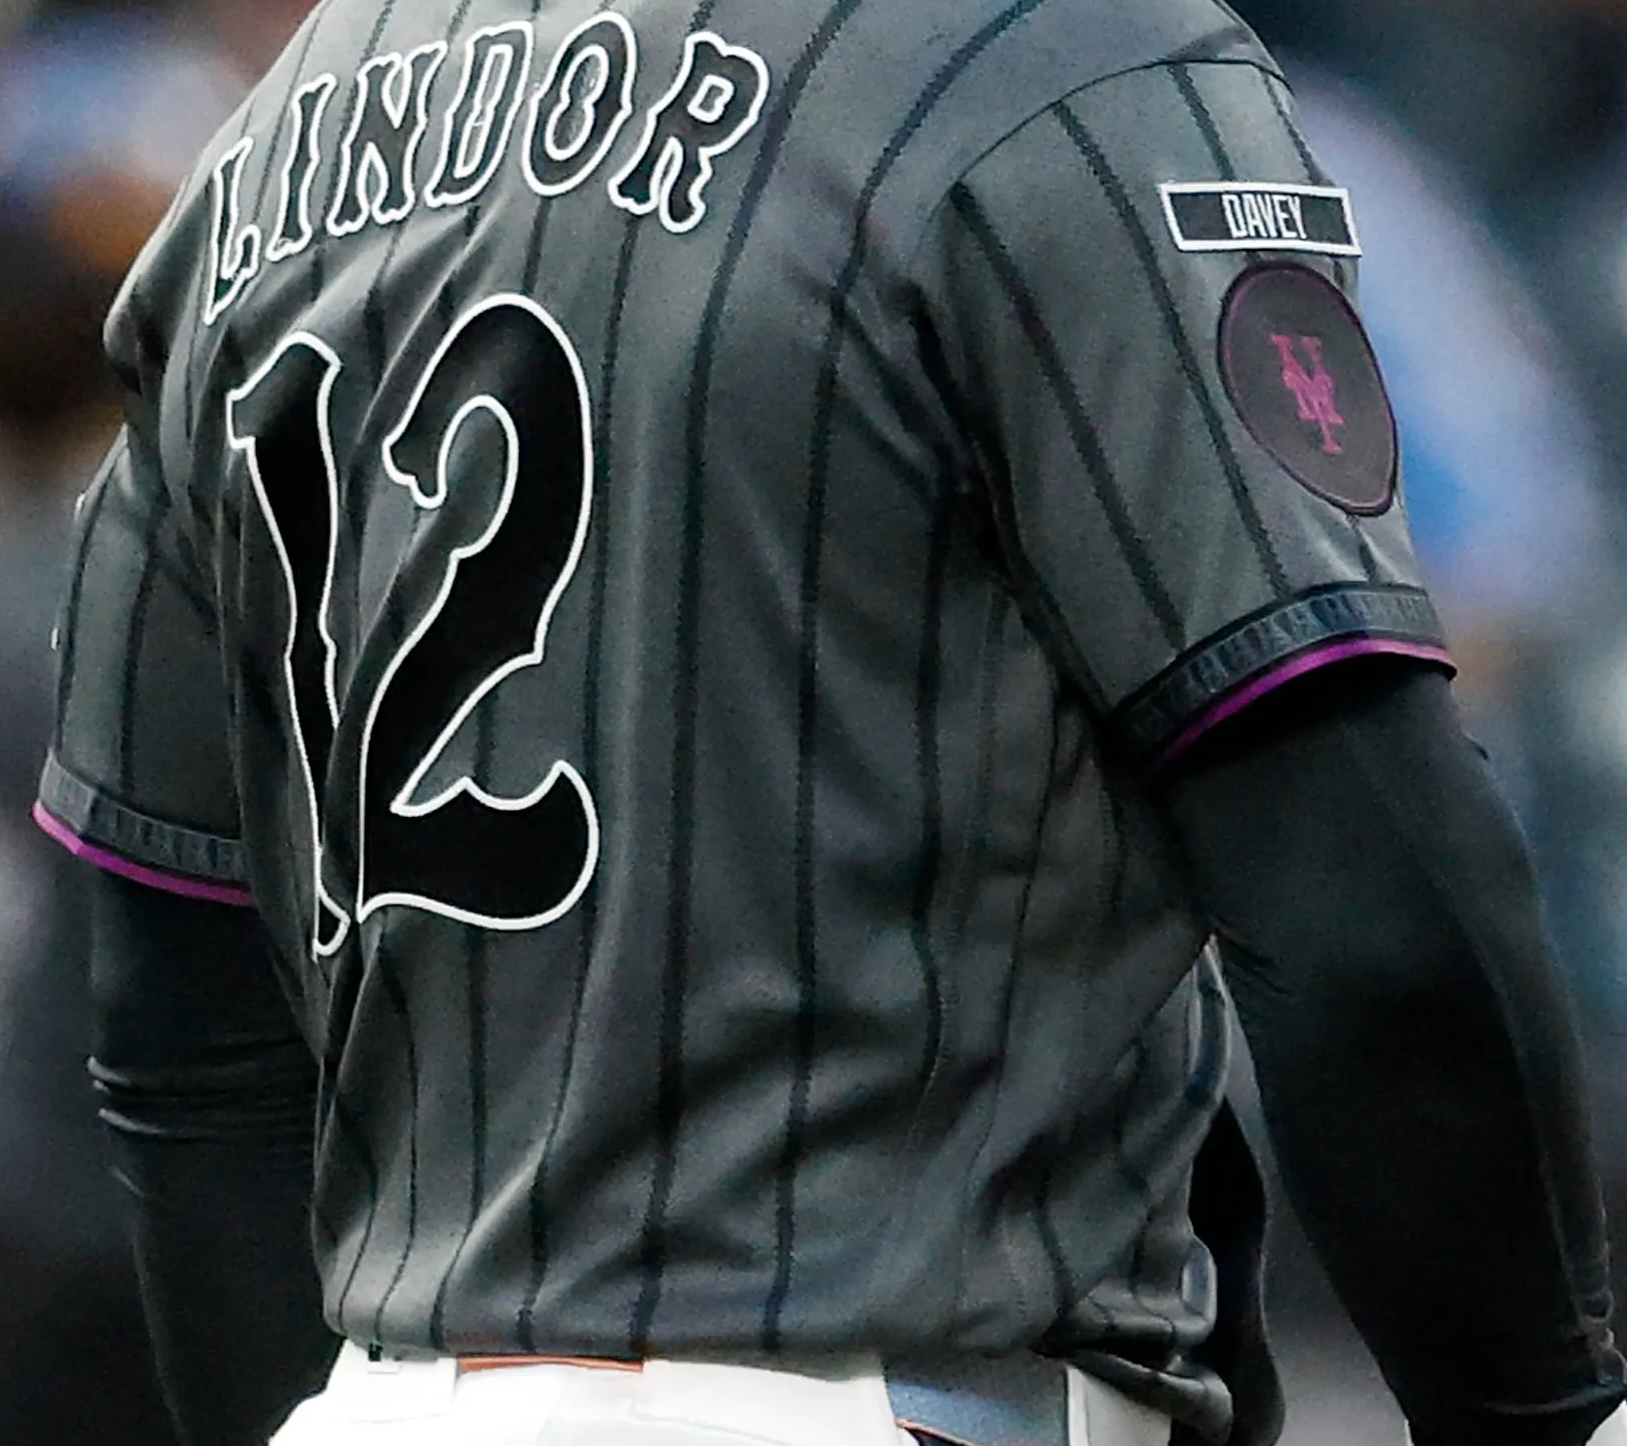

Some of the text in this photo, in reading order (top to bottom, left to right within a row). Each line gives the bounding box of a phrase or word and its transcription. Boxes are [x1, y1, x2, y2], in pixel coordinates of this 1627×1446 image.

[203, 11, 770, 325] LINDOR
[1221, 193, 1308, 240] DAVEY
[226, 292, 601, 963] 12
